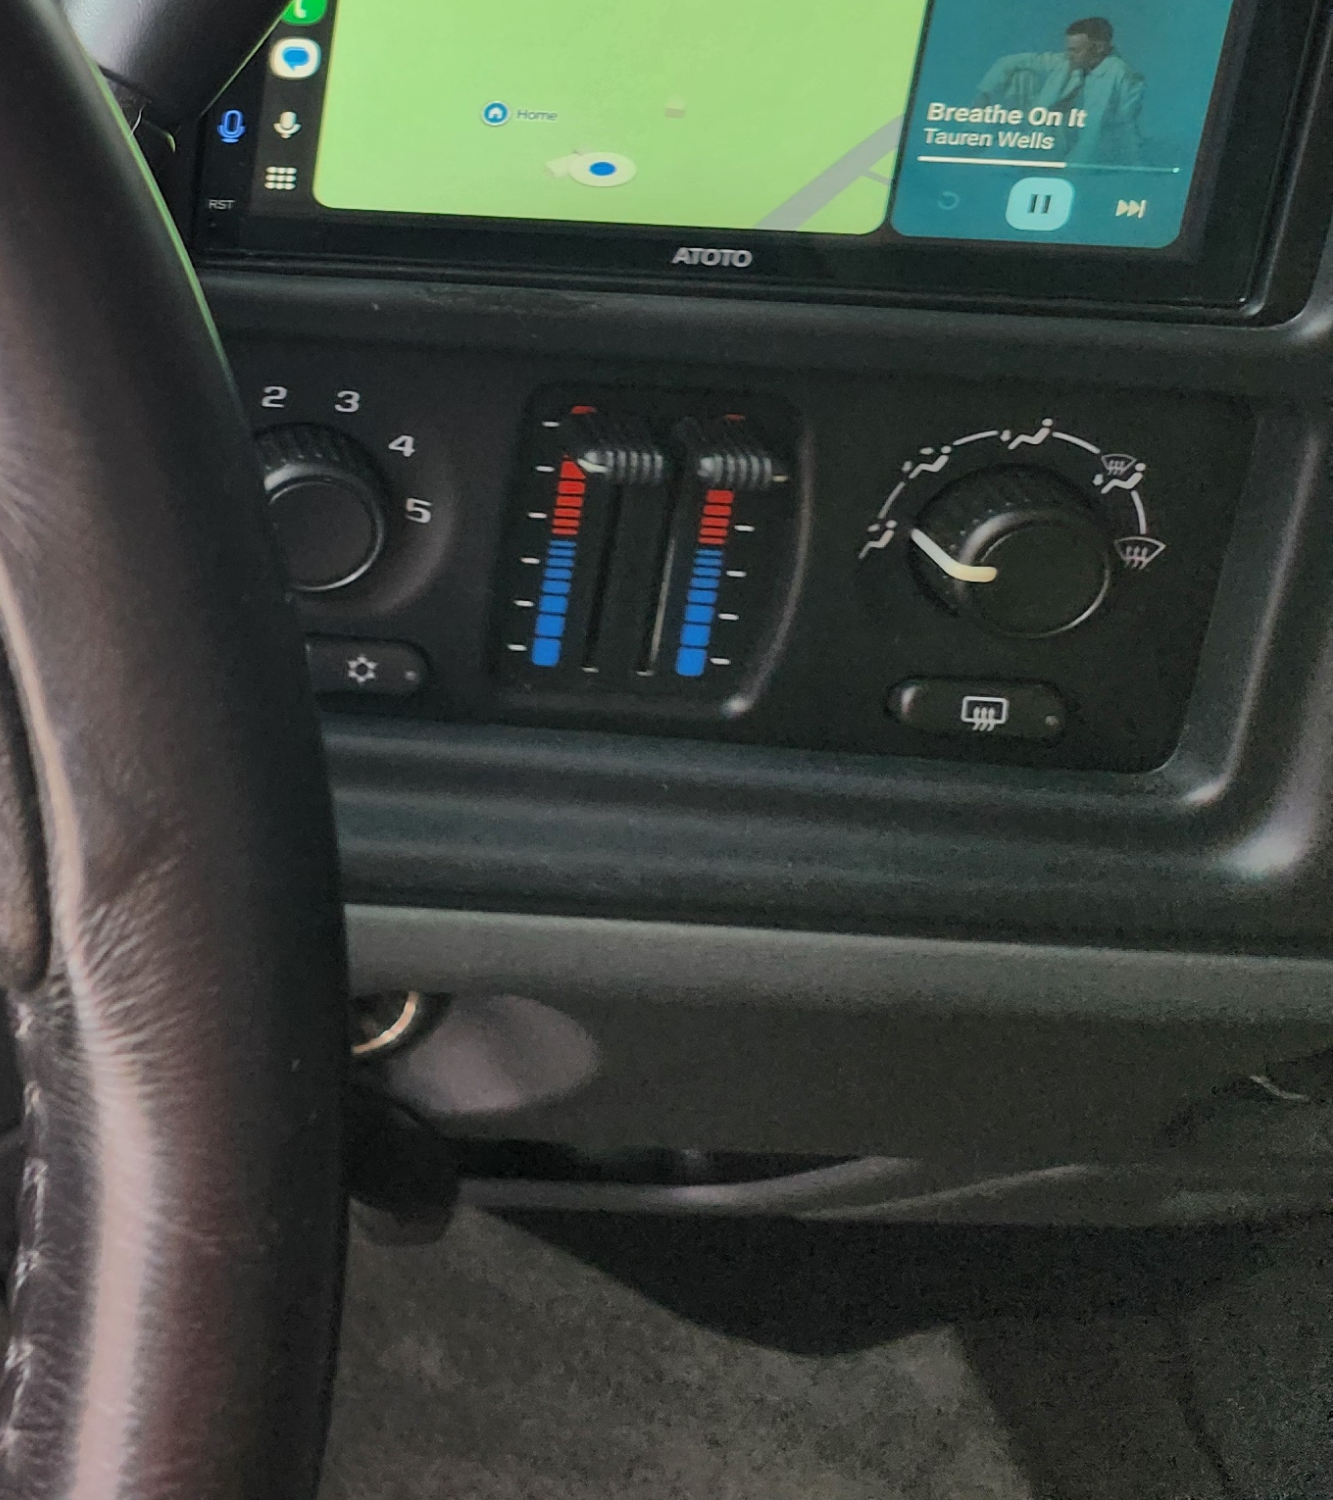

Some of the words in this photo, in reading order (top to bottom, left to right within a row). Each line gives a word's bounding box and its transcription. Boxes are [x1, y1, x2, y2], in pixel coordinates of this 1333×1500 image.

[516, 109, 558, 121] Home
[927, 103, 1022, 126] Breathe
[1029, 106, 1063, 127] On
[1069, 109, 1087, 127] It
[924, 128, 992, 147] Tauren
[998, 131, 1055, 150] Wells
[209, 200, 235, 210] RST
[672, 247, 753, 268] ATOTO
[262, 386, 287, 408] 2
[335, 391, 360, 413] 3
[388, 435, 415, 457] 4
[406, 498, 432, 523] 5
